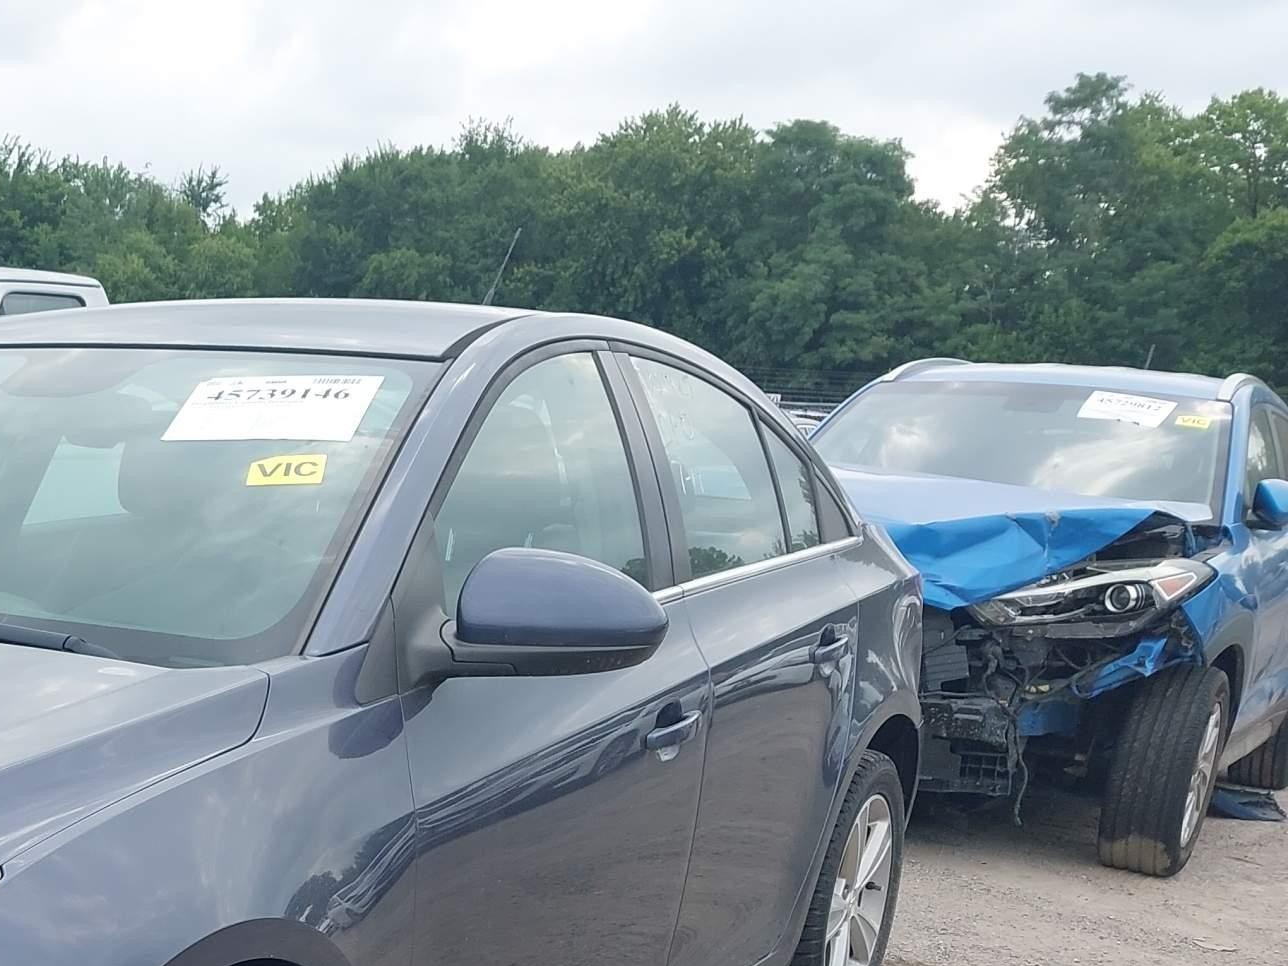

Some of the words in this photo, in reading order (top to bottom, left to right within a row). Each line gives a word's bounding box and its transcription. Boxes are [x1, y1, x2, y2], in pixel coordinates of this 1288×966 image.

[206, 387, 353, 402] 45739146
[1181, 417, 1207, 426] VIC
[256, 461, 319, 478] VIC
